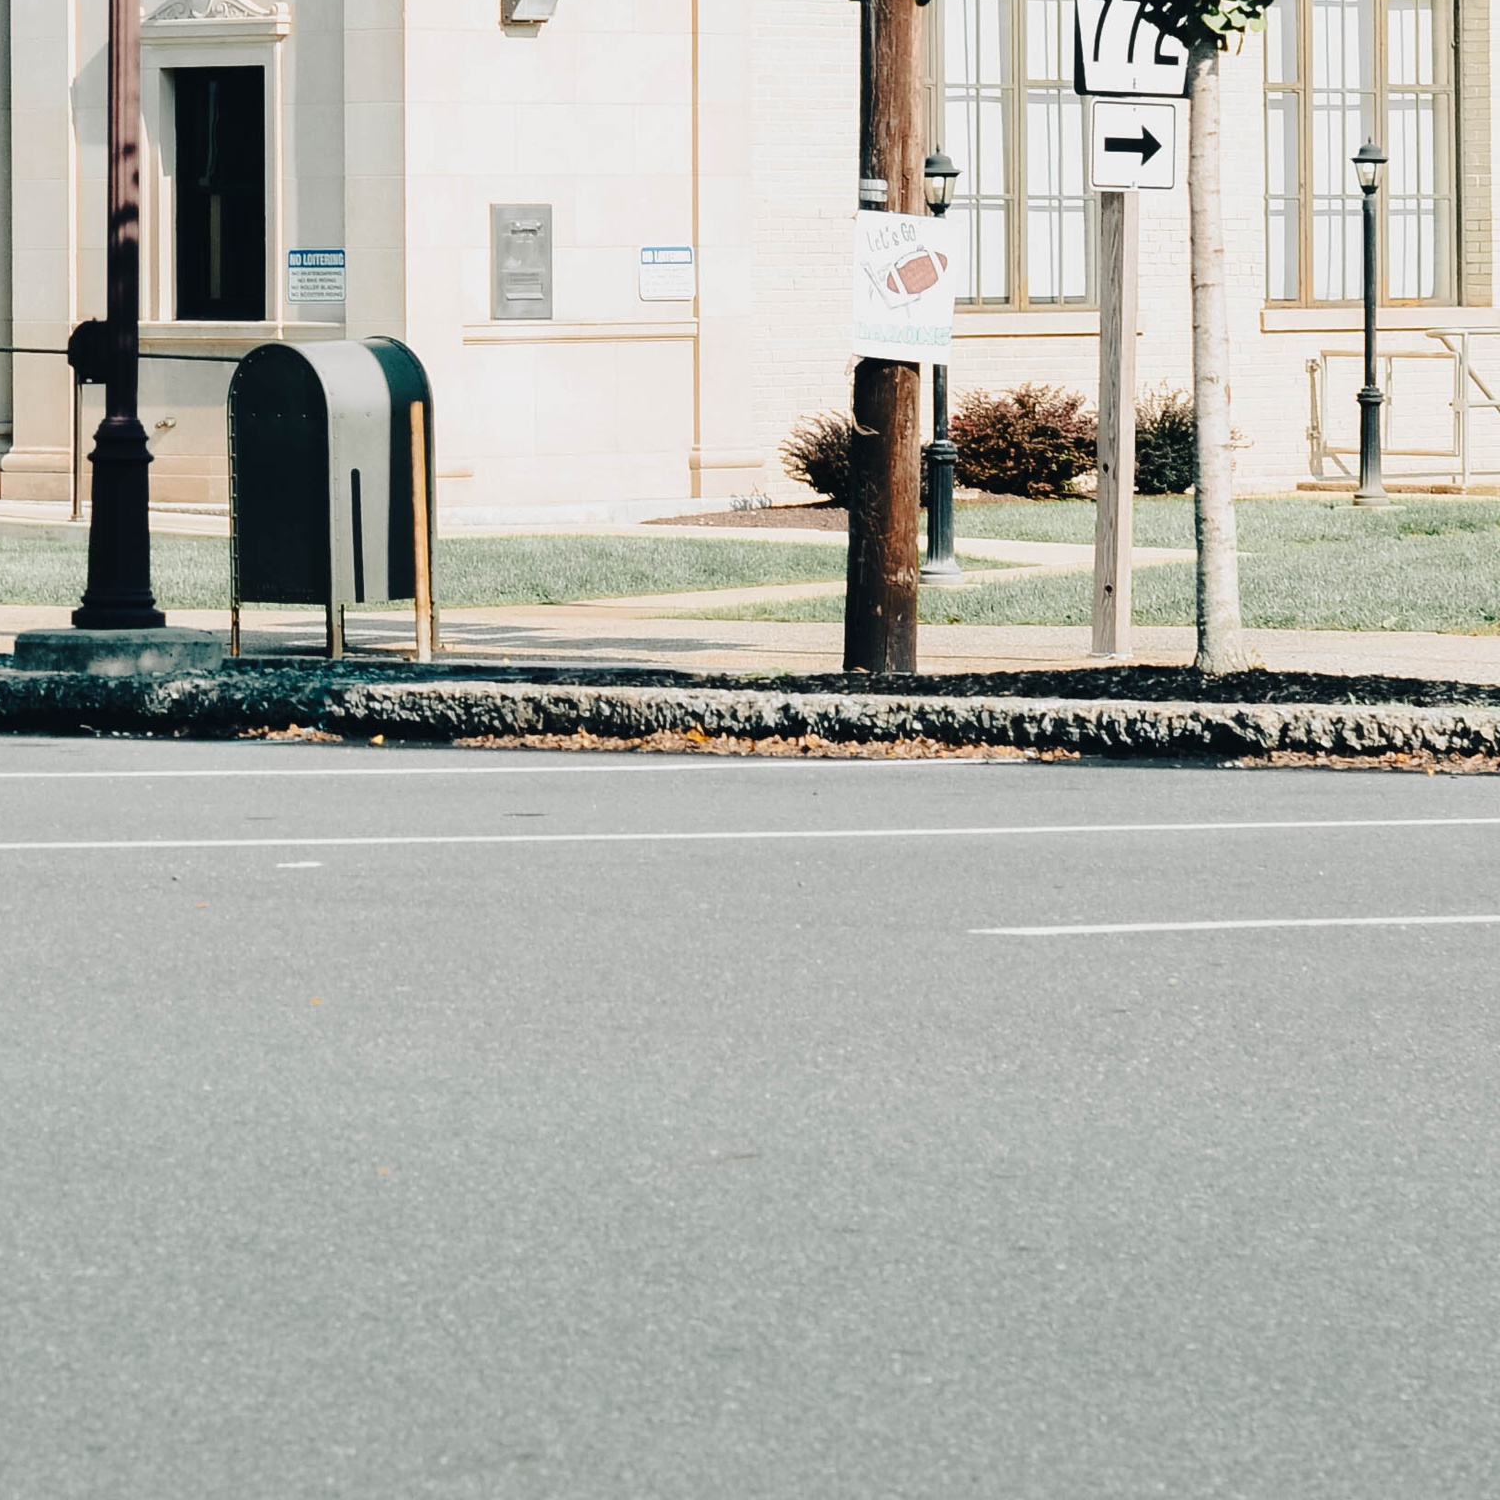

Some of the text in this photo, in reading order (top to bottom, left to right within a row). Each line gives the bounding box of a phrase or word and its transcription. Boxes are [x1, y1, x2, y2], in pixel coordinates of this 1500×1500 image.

[866, 226, 899, 252] Let's
[290, 253, 344, 266] NO LOITERING
